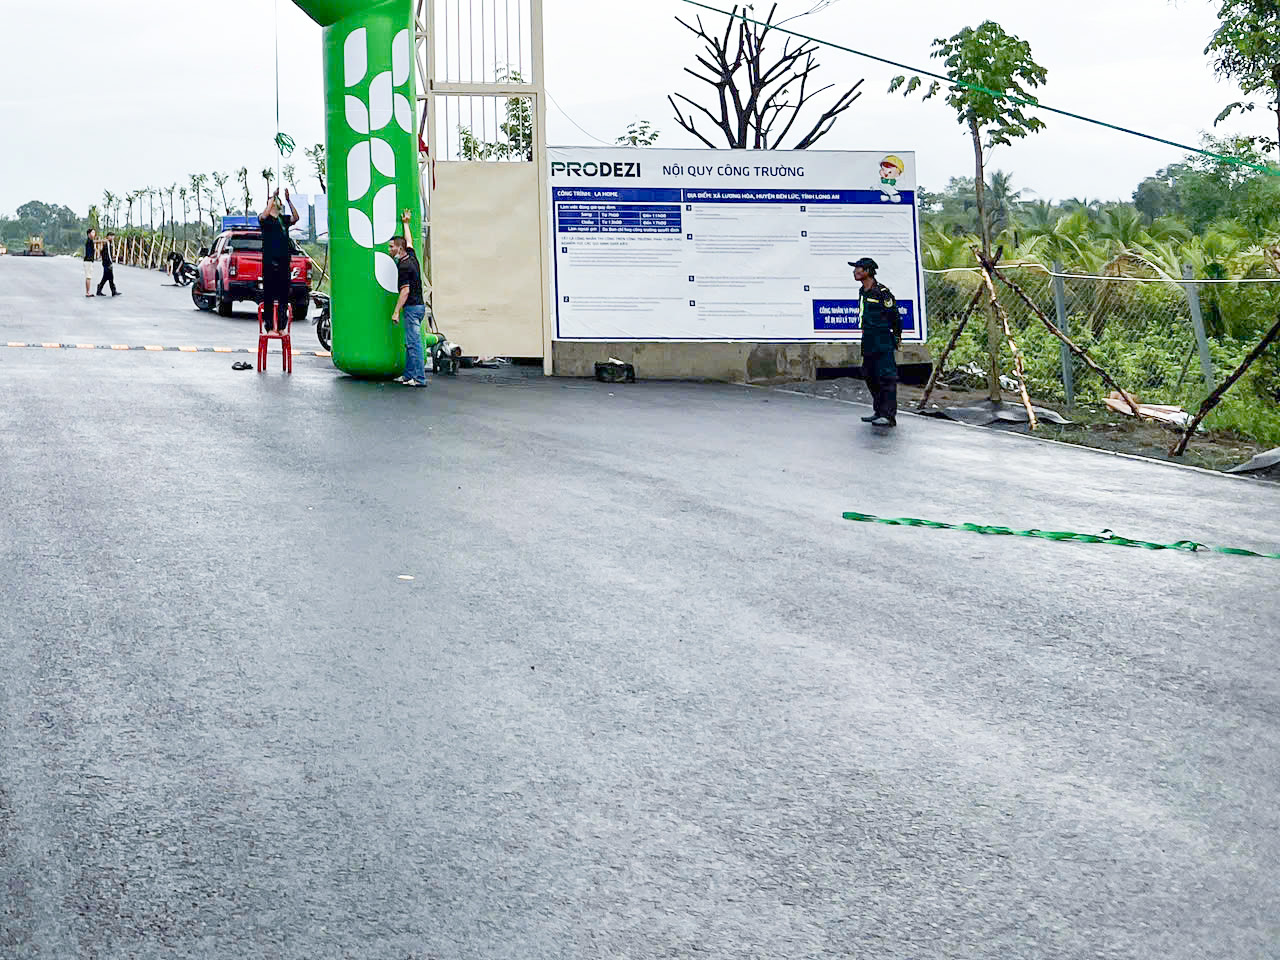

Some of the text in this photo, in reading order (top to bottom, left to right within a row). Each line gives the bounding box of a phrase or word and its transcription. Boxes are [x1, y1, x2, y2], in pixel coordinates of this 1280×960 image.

[552, 162, 804, 177] PRODEZI NỘI QUY CÔNG TRƯỜNG
